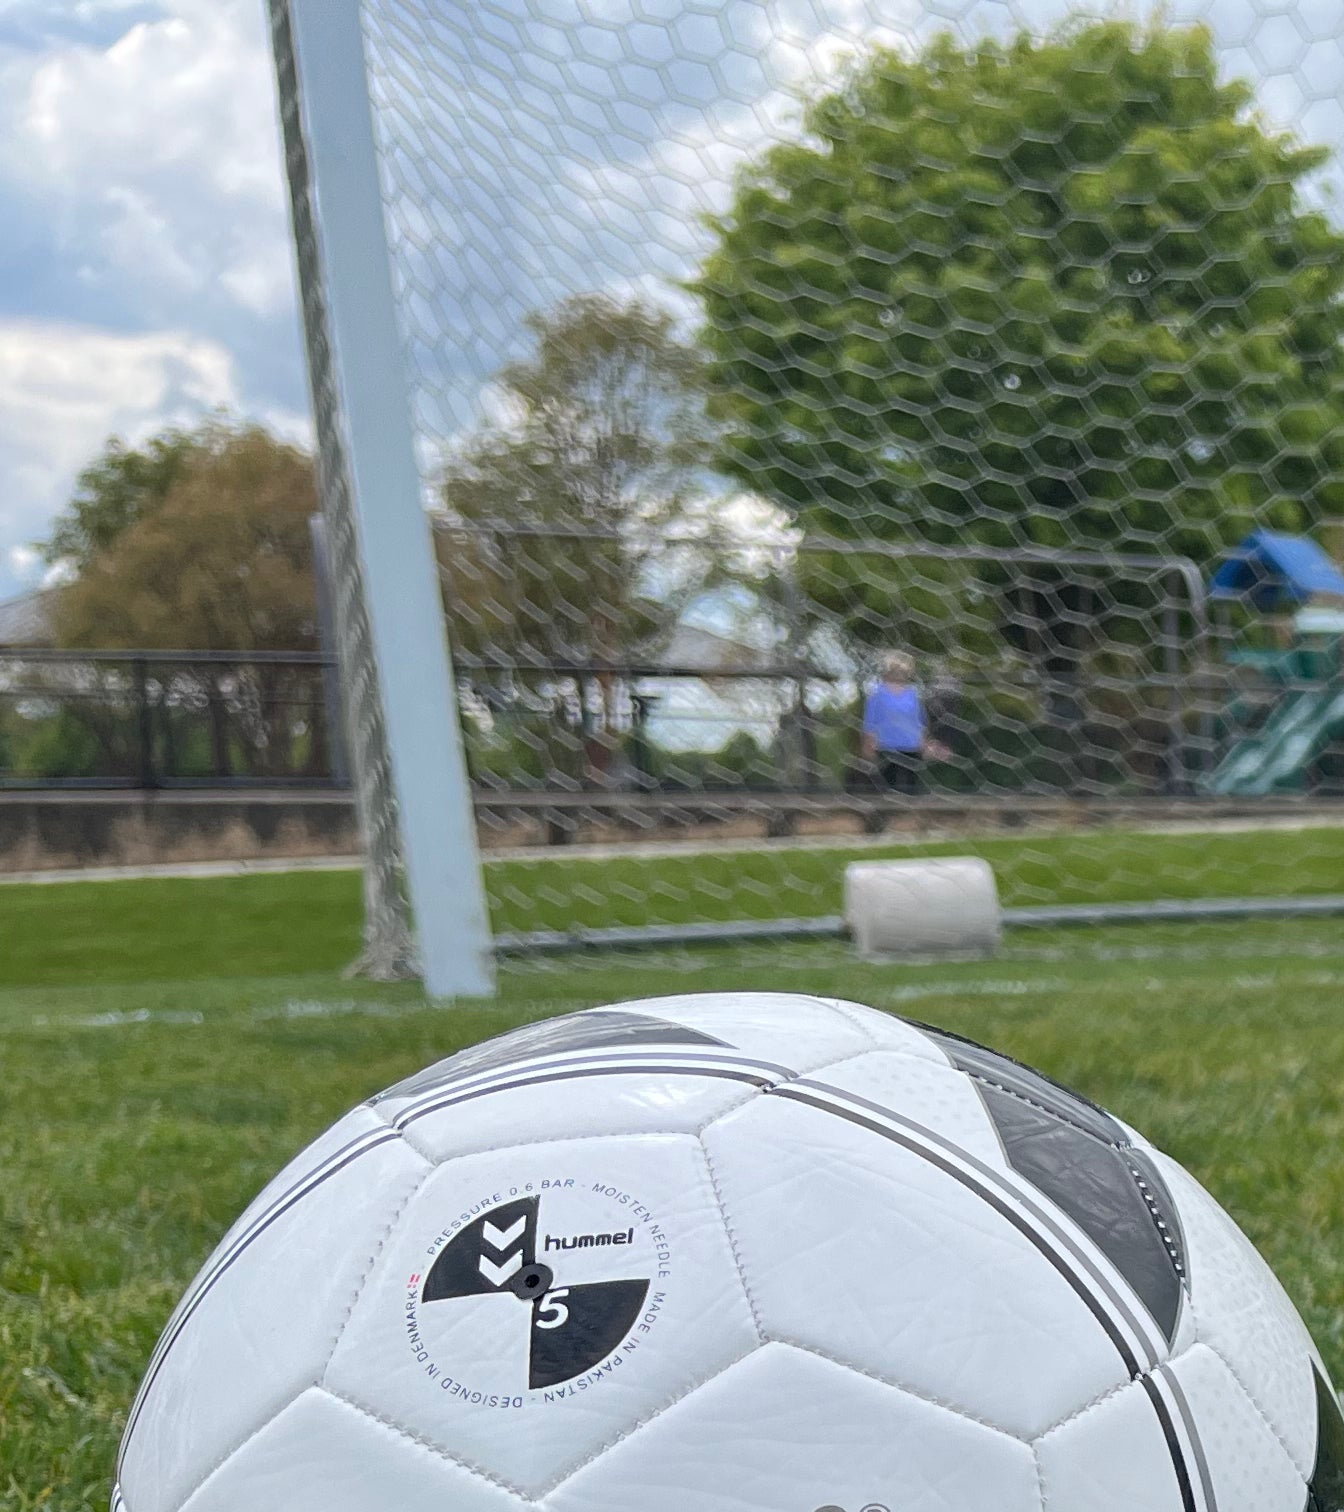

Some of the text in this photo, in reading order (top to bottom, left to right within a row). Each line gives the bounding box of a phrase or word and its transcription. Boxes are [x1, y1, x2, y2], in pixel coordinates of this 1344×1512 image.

[541, 1178, 575, 1189] BAR
[591, 1183, 651, 1223] MOISTEN
[427, 1193, 502, 1256] PRESSURE
[544, 1227, 634, 1251] hummel
[649, 1224, 671, 1278] NEEDLE
[405, 1290, 429, 1364] DENMARK
[535, 1288, 570, 1329] 5
[637, 1291, 667, 1333] MADE
[622, 1337, 641, 1354] IN
[425, 1363, 444, 1380] IN
[544, 1357, 623, 1402] PAKISTAN
[440, 1377, 523, 1408] DESIGNED
